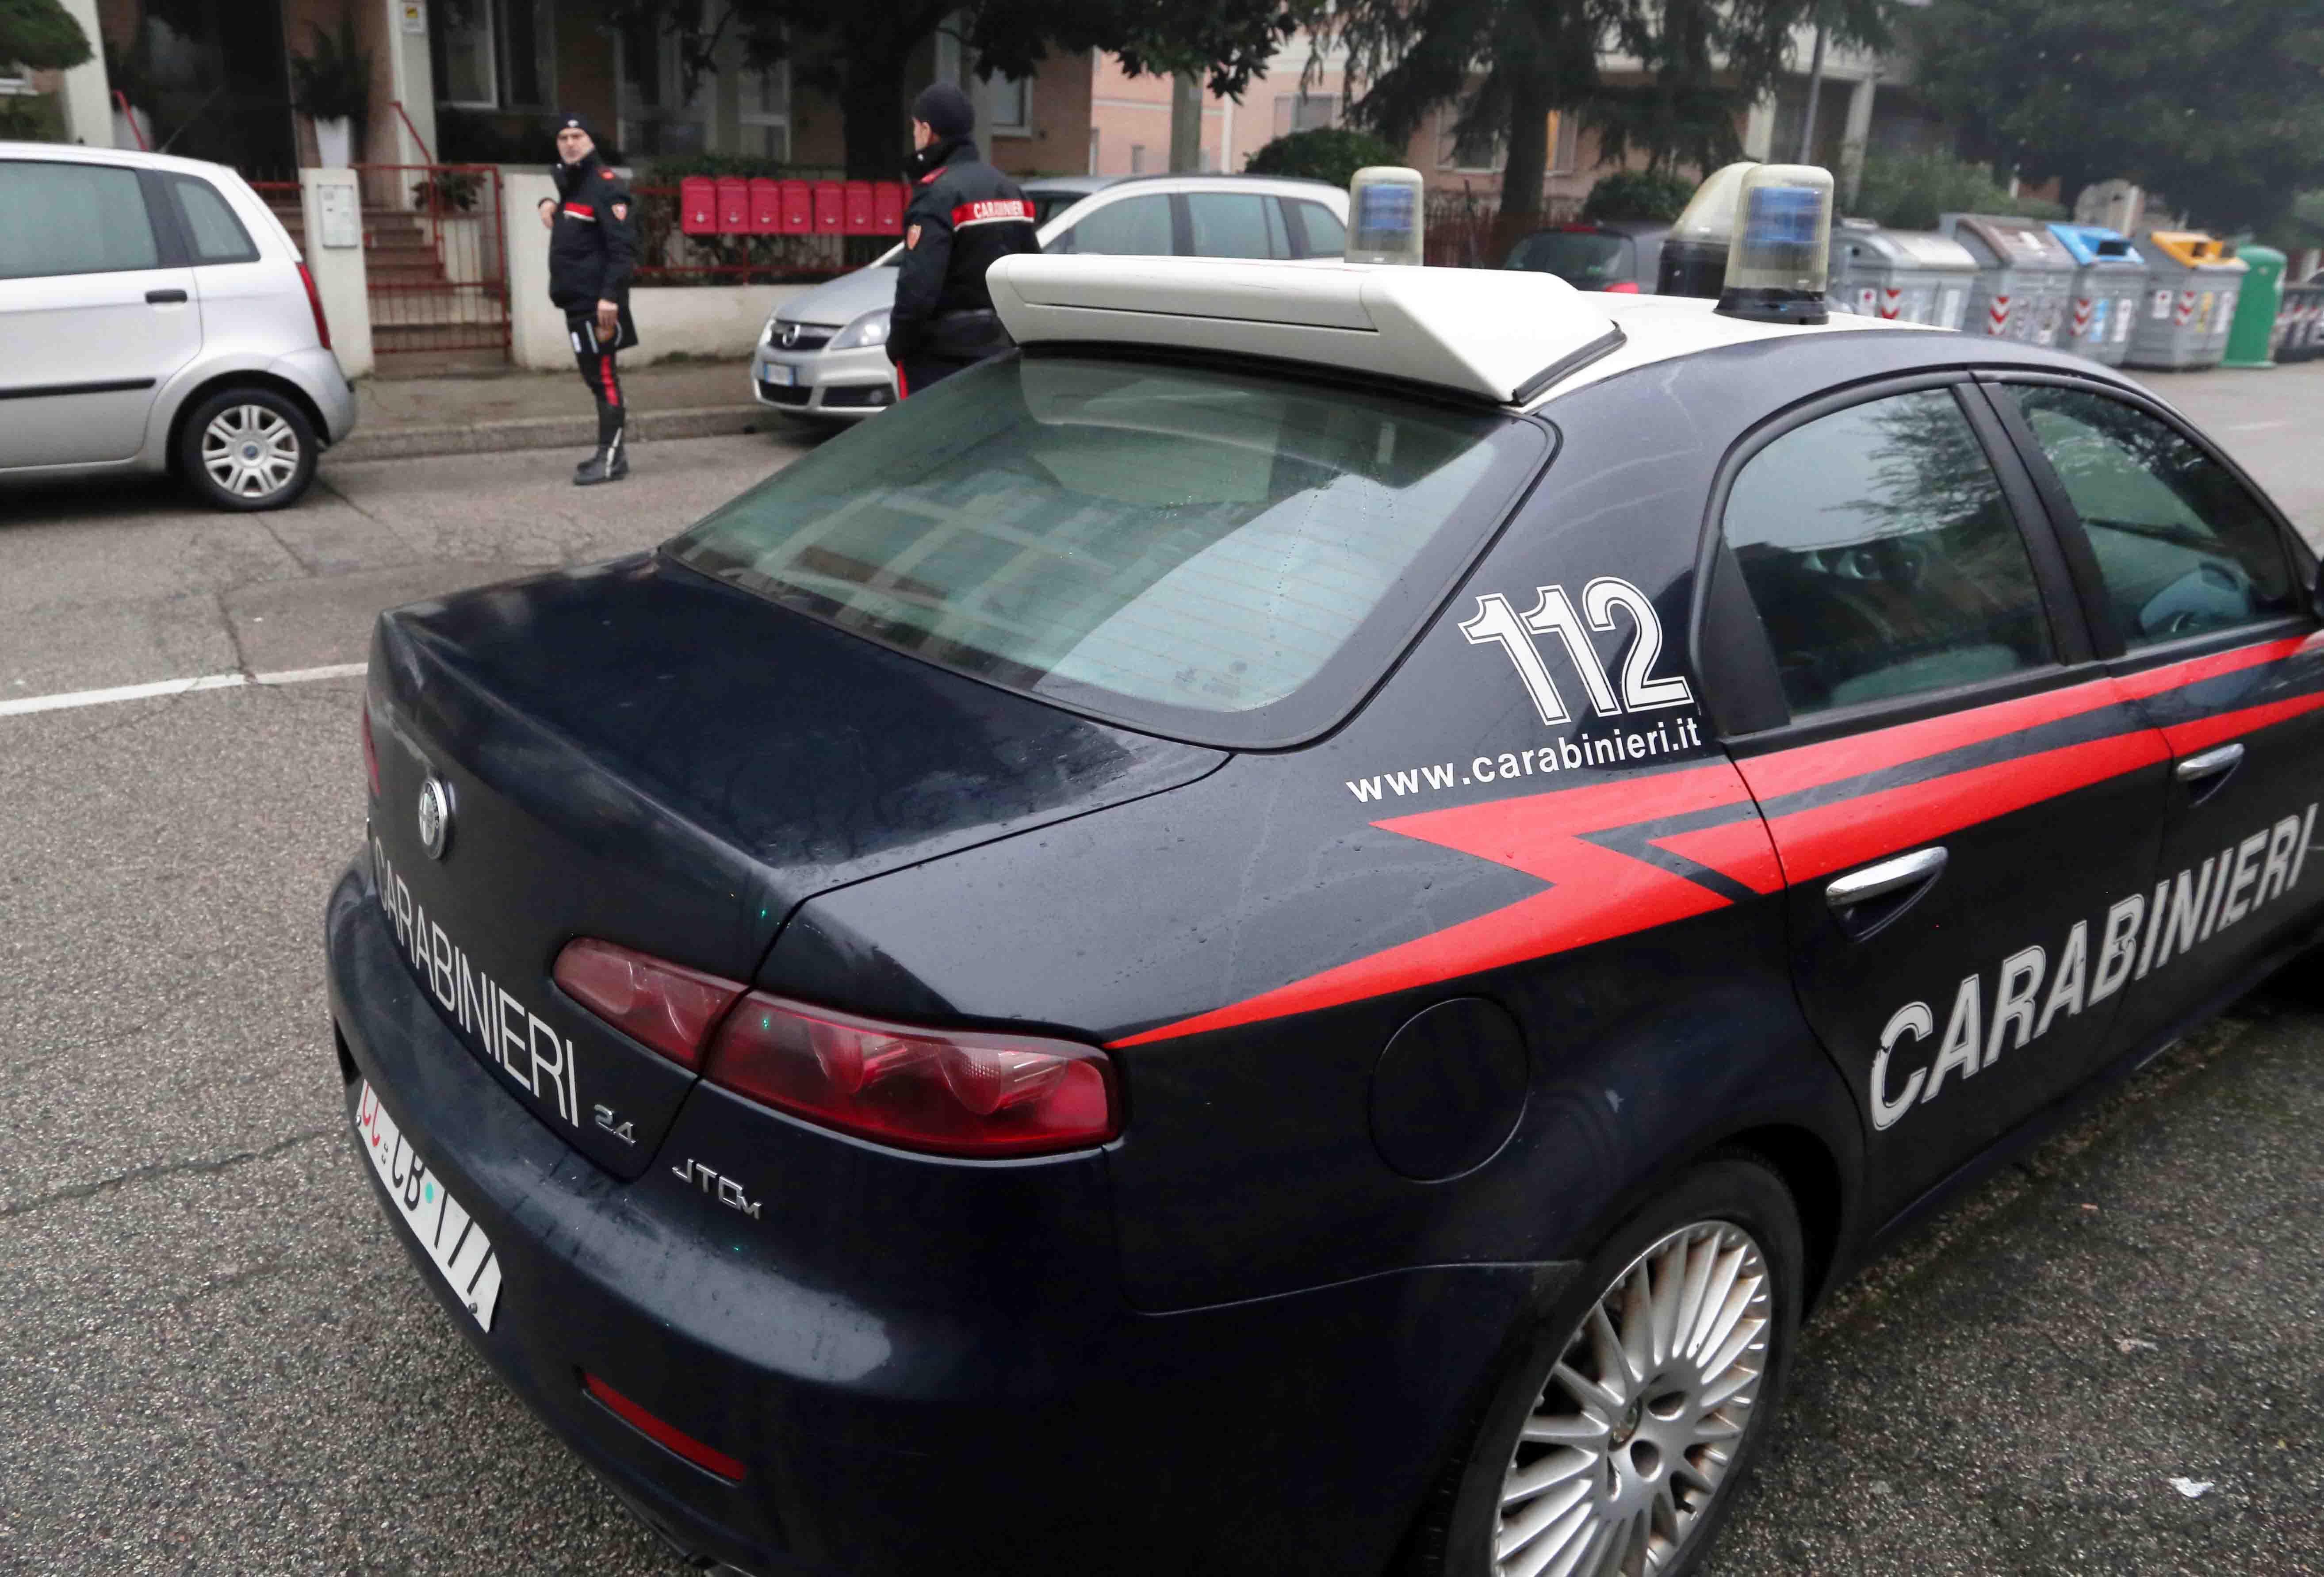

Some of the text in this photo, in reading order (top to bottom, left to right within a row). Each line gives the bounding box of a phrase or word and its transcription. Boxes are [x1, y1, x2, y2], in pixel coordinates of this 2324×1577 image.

[1346, 717, 1701, 803] www.carabinieri.it
[1458, 576, 1694, 726] 112
[375, 836, 578, 1128] CARABINIERI
[1870, 802, 2319, 1131] CARABINIERI
